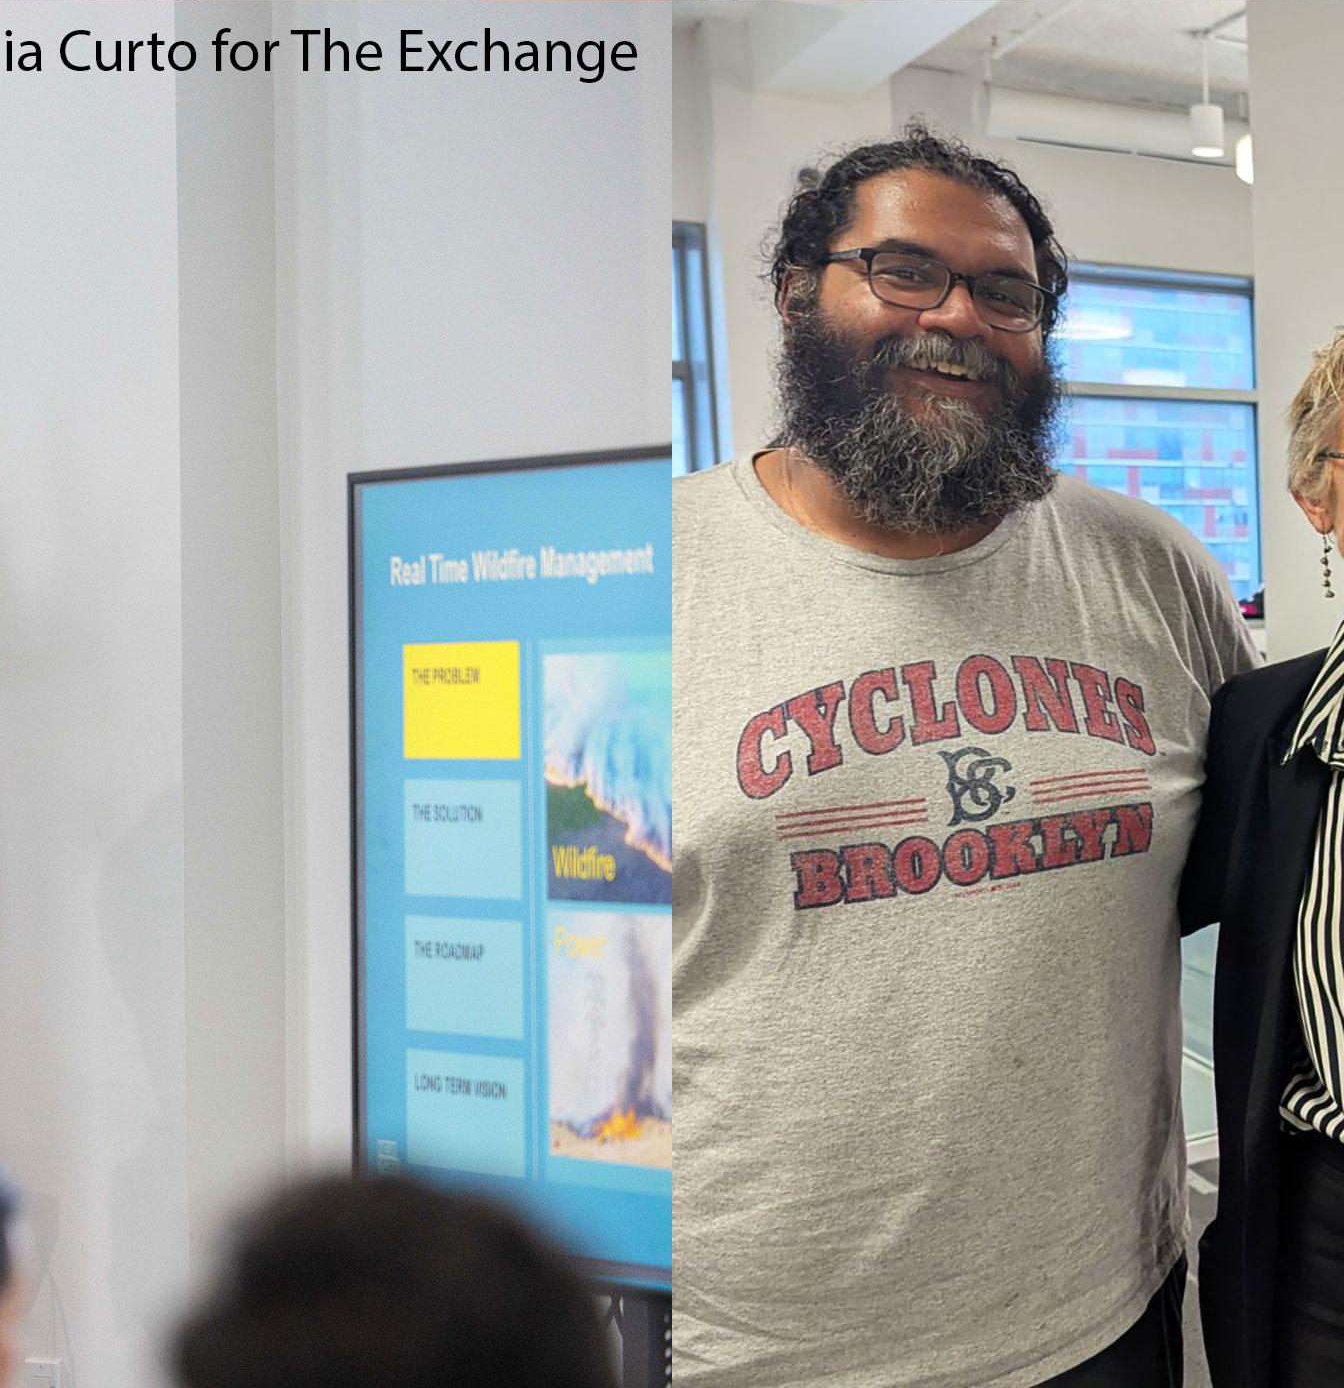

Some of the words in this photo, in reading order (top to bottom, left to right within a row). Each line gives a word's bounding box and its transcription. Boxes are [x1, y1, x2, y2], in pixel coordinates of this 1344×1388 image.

[390, 555, 426, 586] Real
[428, 552, 468, 584] Time
[471, 548, 537, 581] Wildfire
[539, 541, 654, 586] Management
[736, 653, 1157, 800] CYCLONES
[552, 845, 616, 882] Wildfire
[789, 802, 1154, 910] BROOKLYN
